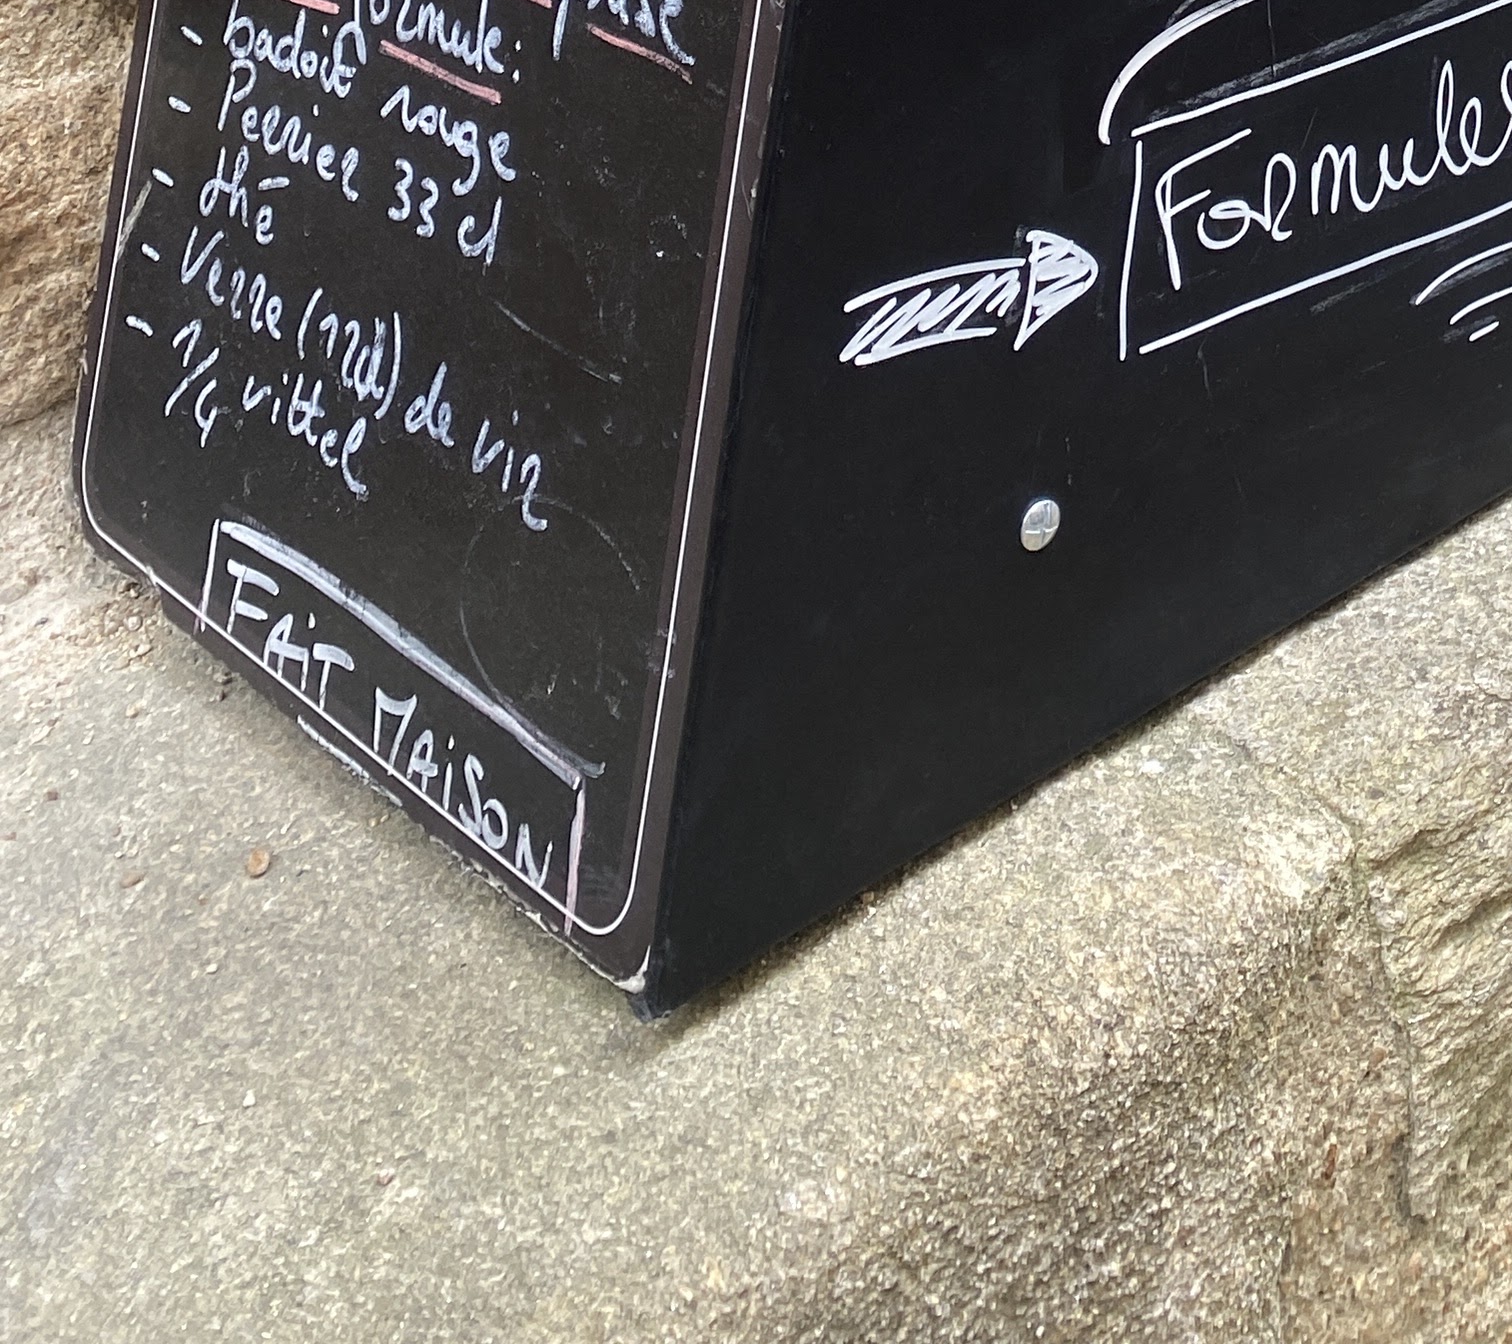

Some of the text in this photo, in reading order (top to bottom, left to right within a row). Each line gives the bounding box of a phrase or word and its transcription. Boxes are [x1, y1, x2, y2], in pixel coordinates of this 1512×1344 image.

[217, 58, 360, 201] Perrier
[387, 157, 440, 238] 33
[456, 196, 503, 266] cl
[379, 83, 518, 197] rouge
[404, 360, 456, 449] de
[471, 409, 549, 532] vin
